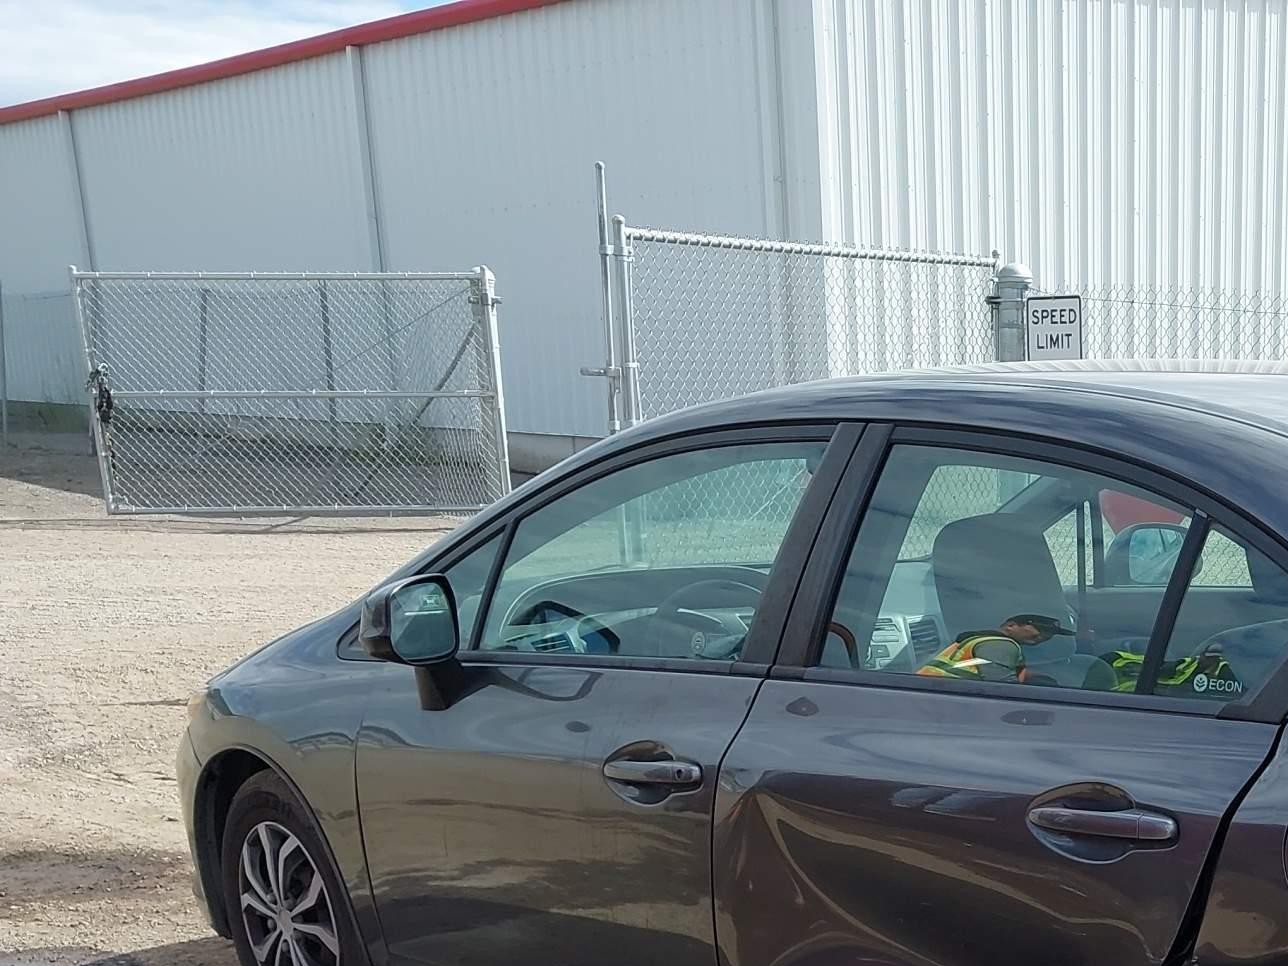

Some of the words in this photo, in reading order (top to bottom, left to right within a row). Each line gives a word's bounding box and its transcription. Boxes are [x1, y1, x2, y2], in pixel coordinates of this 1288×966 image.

[1031, 308, 1077, 325] SPEED
[1036, 333, 1073, 349] LIMIT
[1208, 678, 1243, 693] ECON
